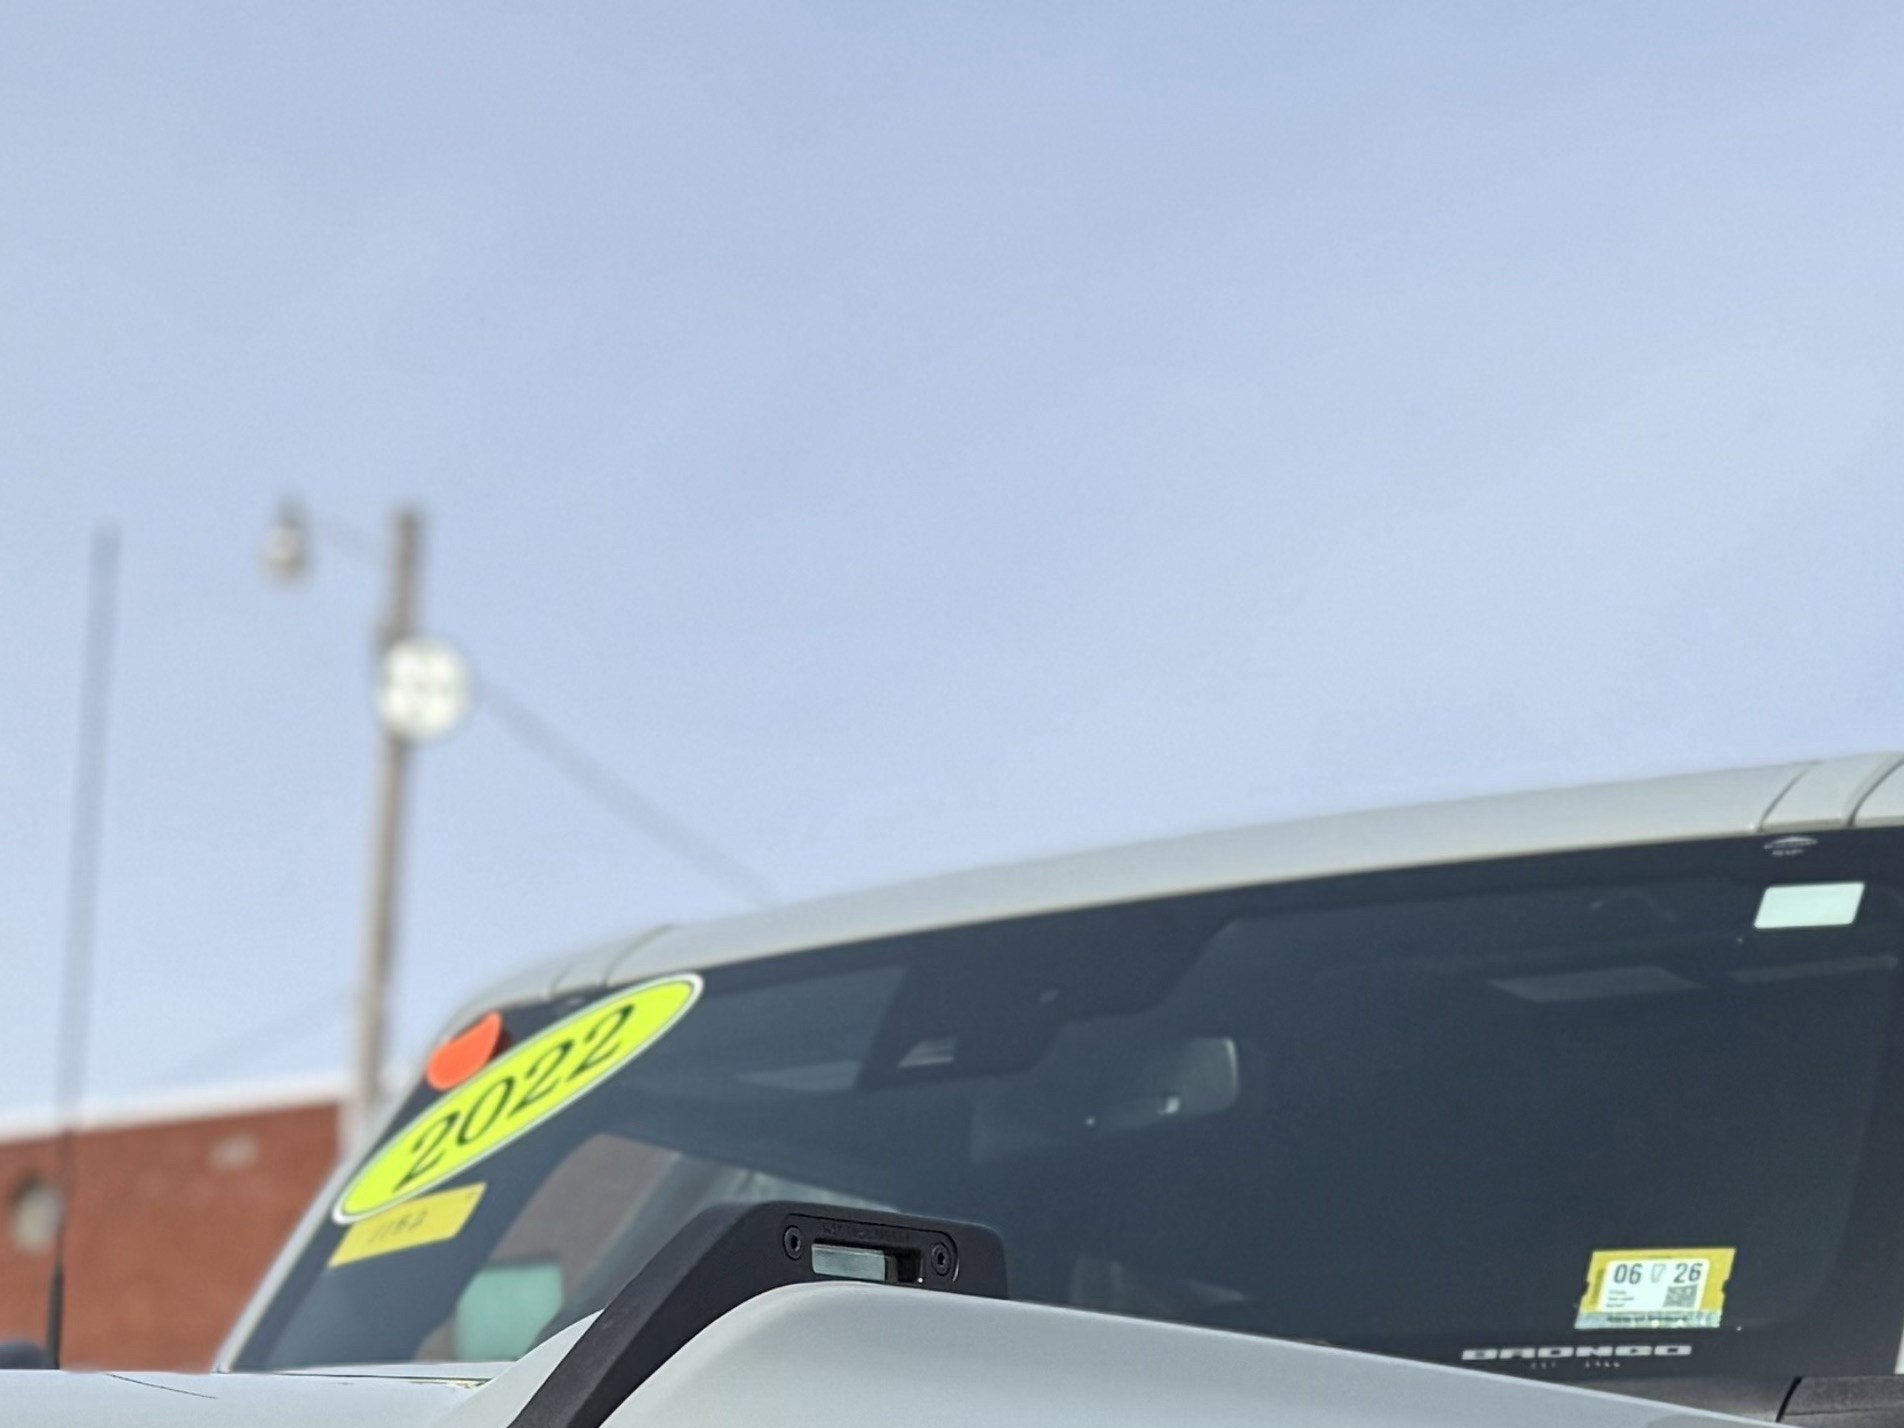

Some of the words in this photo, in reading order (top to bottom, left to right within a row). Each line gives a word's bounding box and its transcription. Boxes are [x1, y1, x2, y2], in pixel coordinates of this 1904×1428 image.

[391, 1002, 635, 1195] 2022
[1613, 1263, 1643, 1285] 06
[1673, 1262, 1703, 1284] 26
[1462, 1345, 1692, 1360] BRONCO
